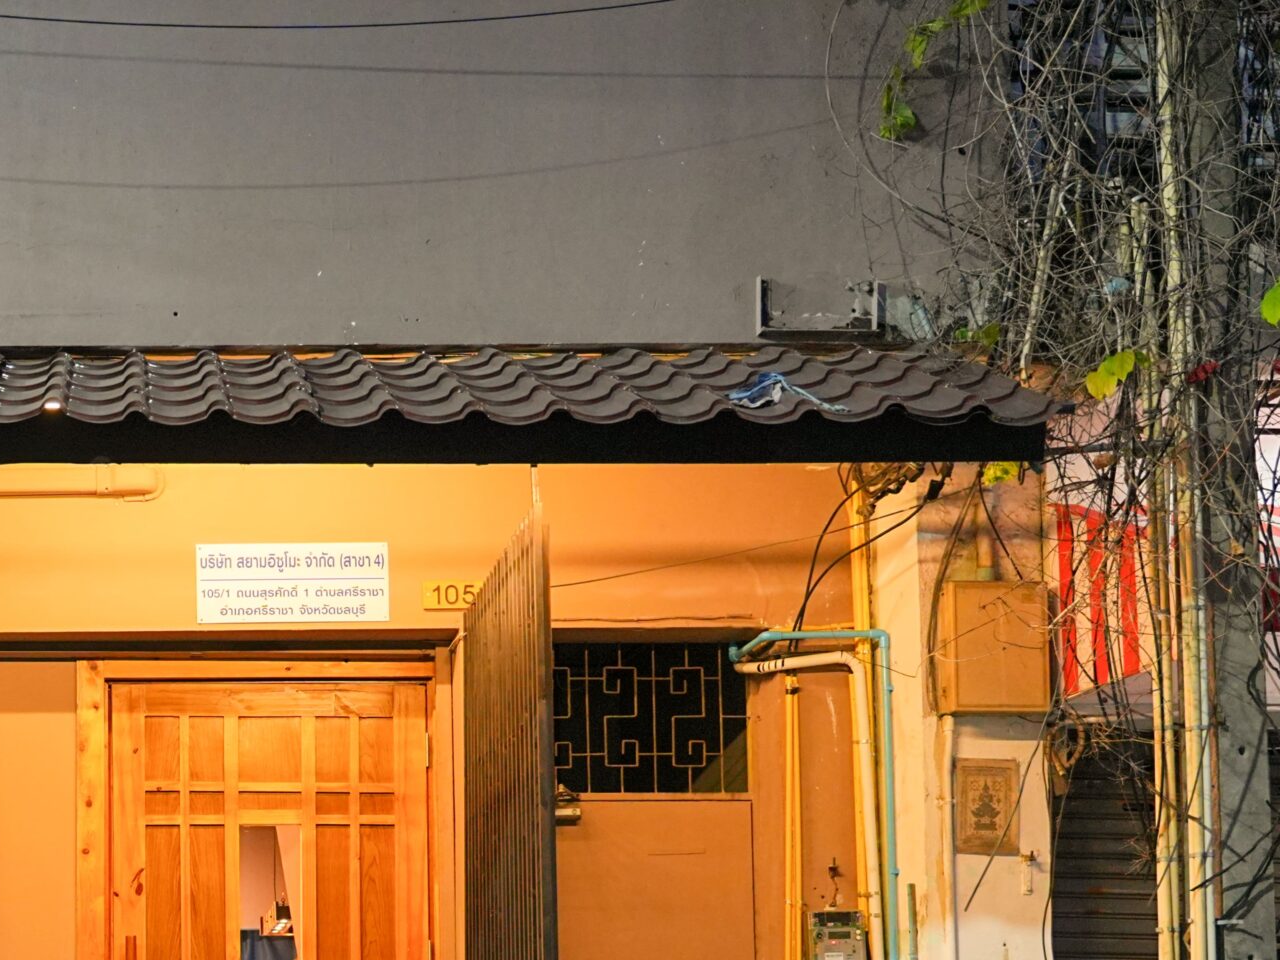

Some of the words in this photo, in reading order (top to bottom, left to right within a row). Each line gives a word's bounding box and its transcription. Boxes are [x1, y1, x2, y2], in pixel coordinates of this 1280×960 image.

[199, 552, 232, 570] บริษัท
[236, 551, 301, 573] สยามอิซูโมะ
[305, 551, 336, 569] จำกัด
[339, 553, 373, 570] (สาขา
[373, 552, 385, 570] 4)
[201, 588, 231, 599] 105/1
[304, 588, 310, 598] 1
[315, 586, 385, 599] ตำบลศรีราชา
[432, 584, 477, 606] 105
[220, 604, 294, 617] อำเภอศรีราชา
[299, 603, 367, 618] จังหวัดชลบุรี
